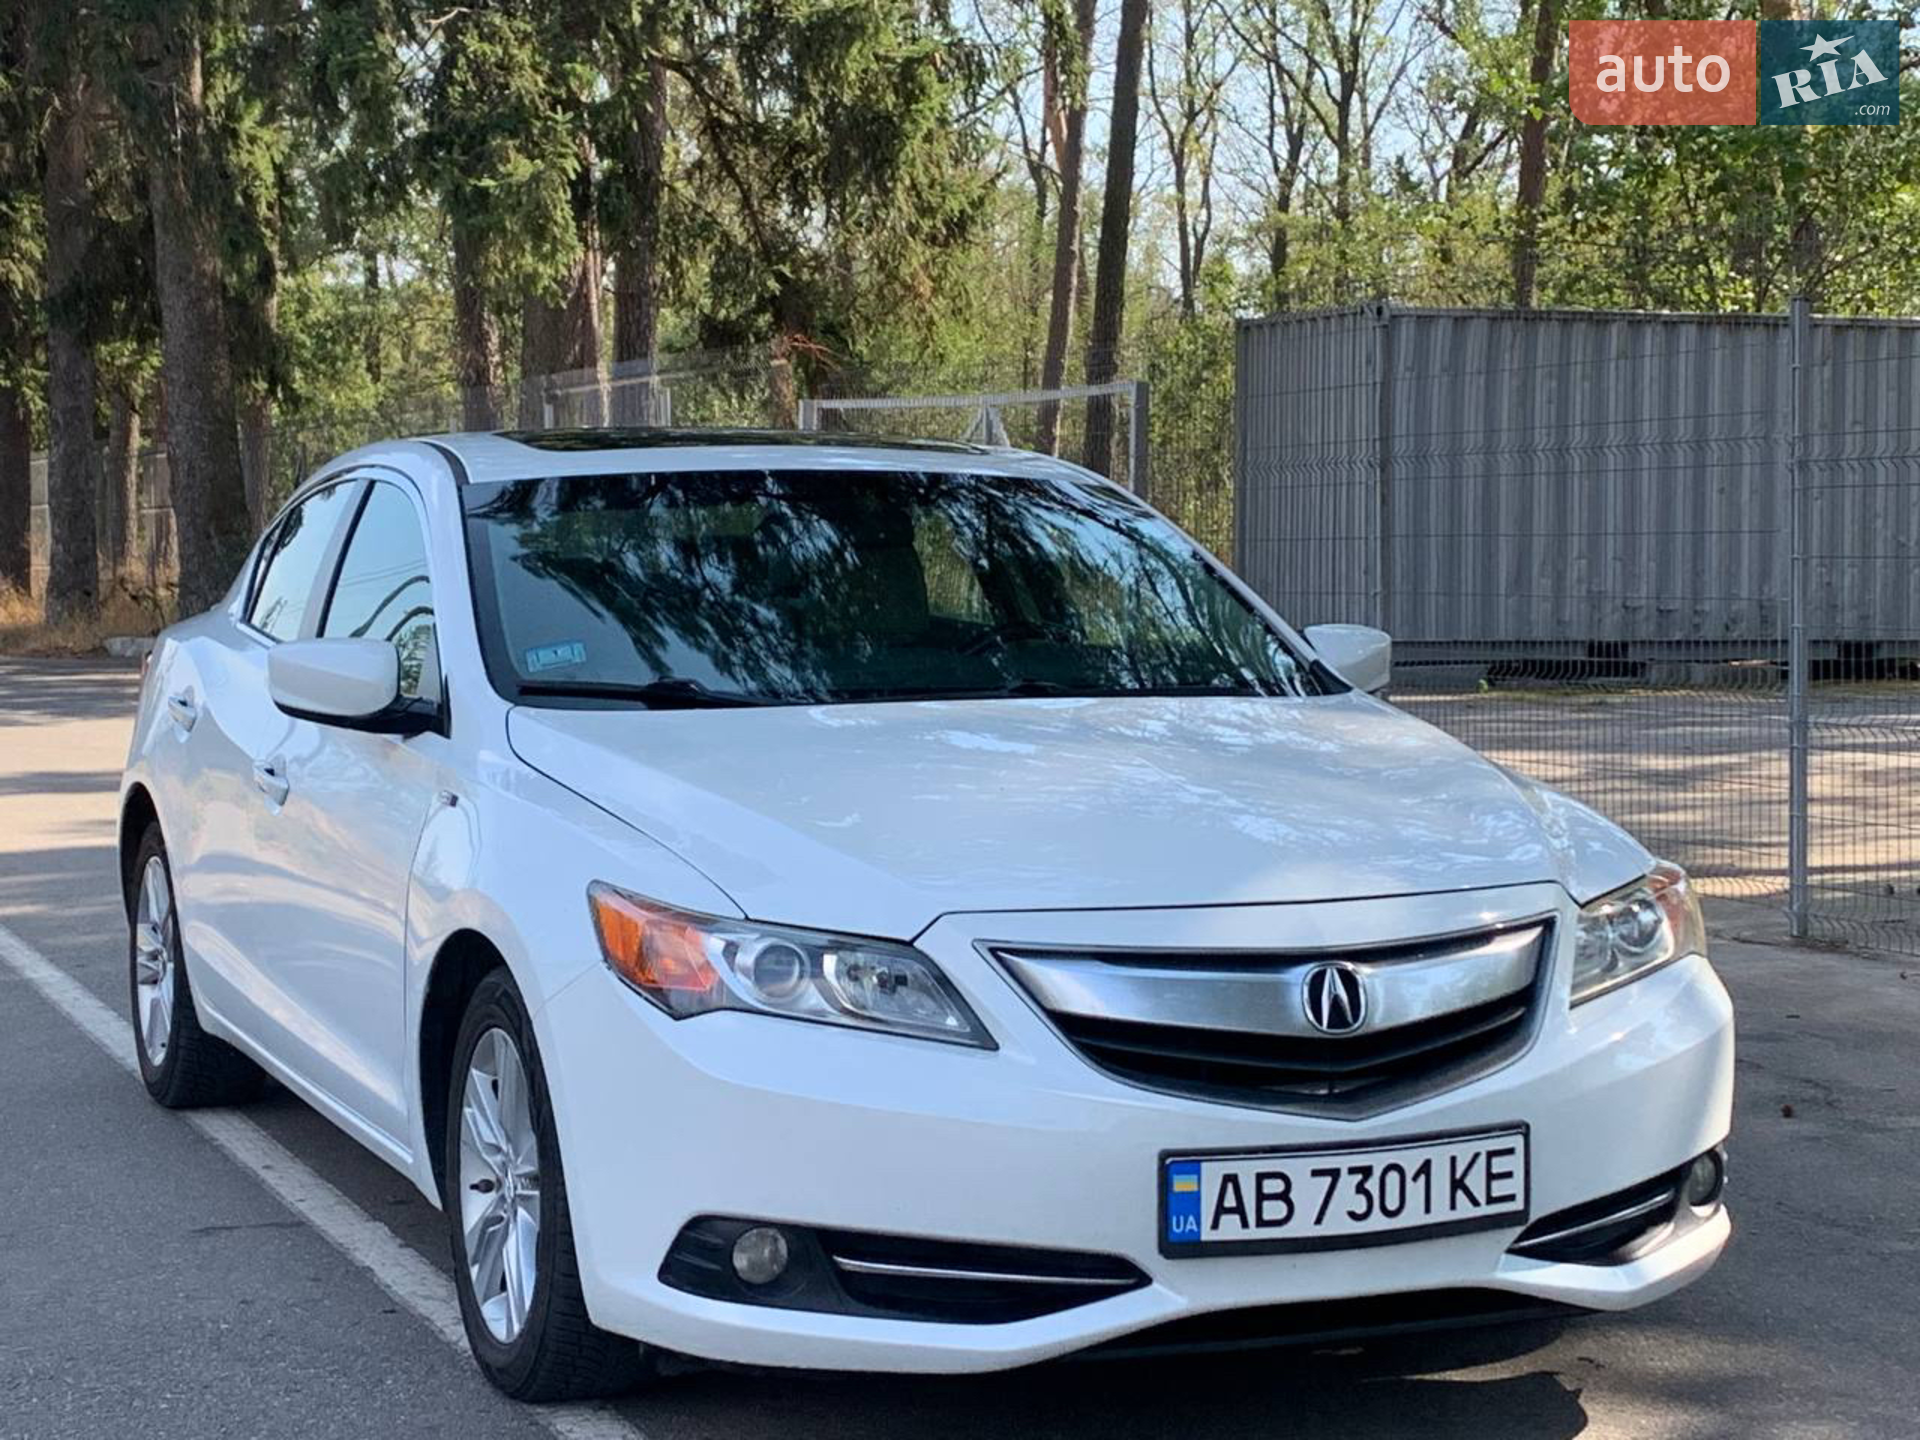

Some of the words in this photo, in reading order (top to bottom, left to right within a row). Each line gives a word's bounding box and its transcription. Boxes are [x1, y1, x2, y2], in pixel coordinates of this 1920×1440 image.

[1210, 1171, 1295, 1231] AB
[1310, 1158, 1433, 1226] 7301
[1450, 1147, 1516, 1211] KE
[1172, 1215, 1198, 1233] UA
